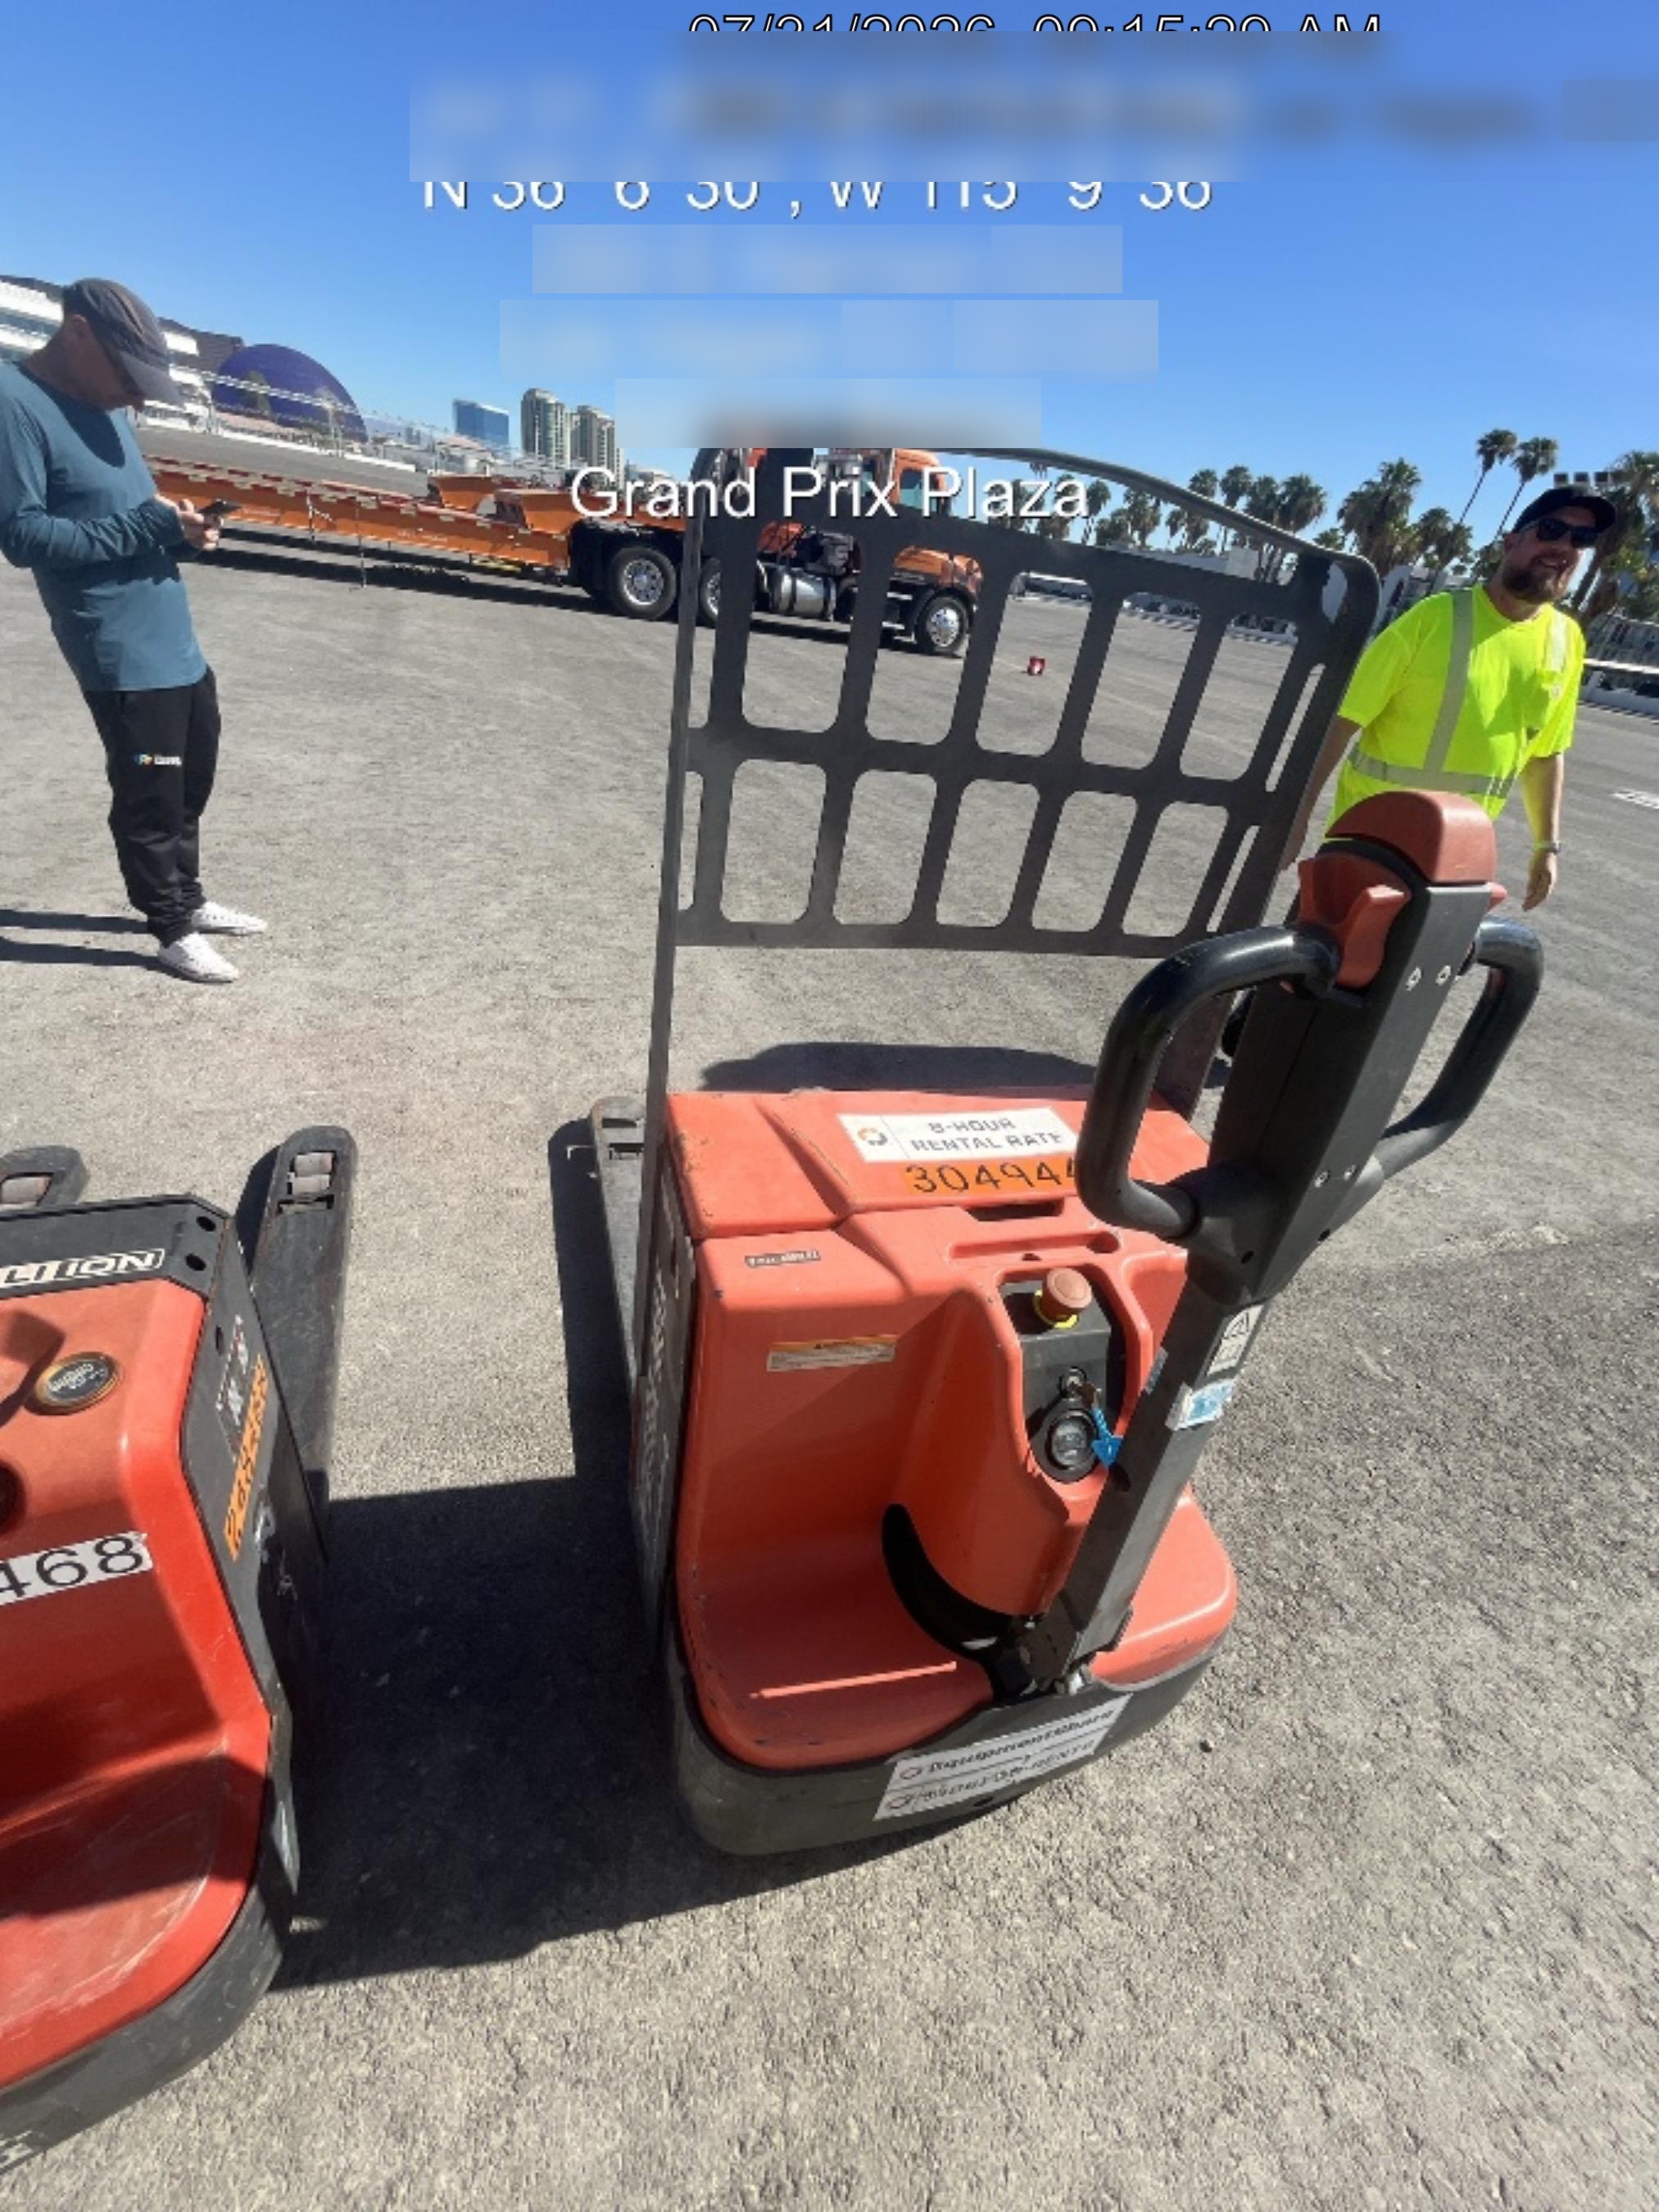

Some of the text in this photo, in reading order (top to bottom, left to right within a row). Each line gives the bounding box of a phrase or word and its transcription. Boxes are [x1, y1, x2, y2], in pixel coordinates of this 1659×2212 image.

[911, 1131, 1063, 1151] RENTAL RATE
[0, 1536, 143, 1598] 468
